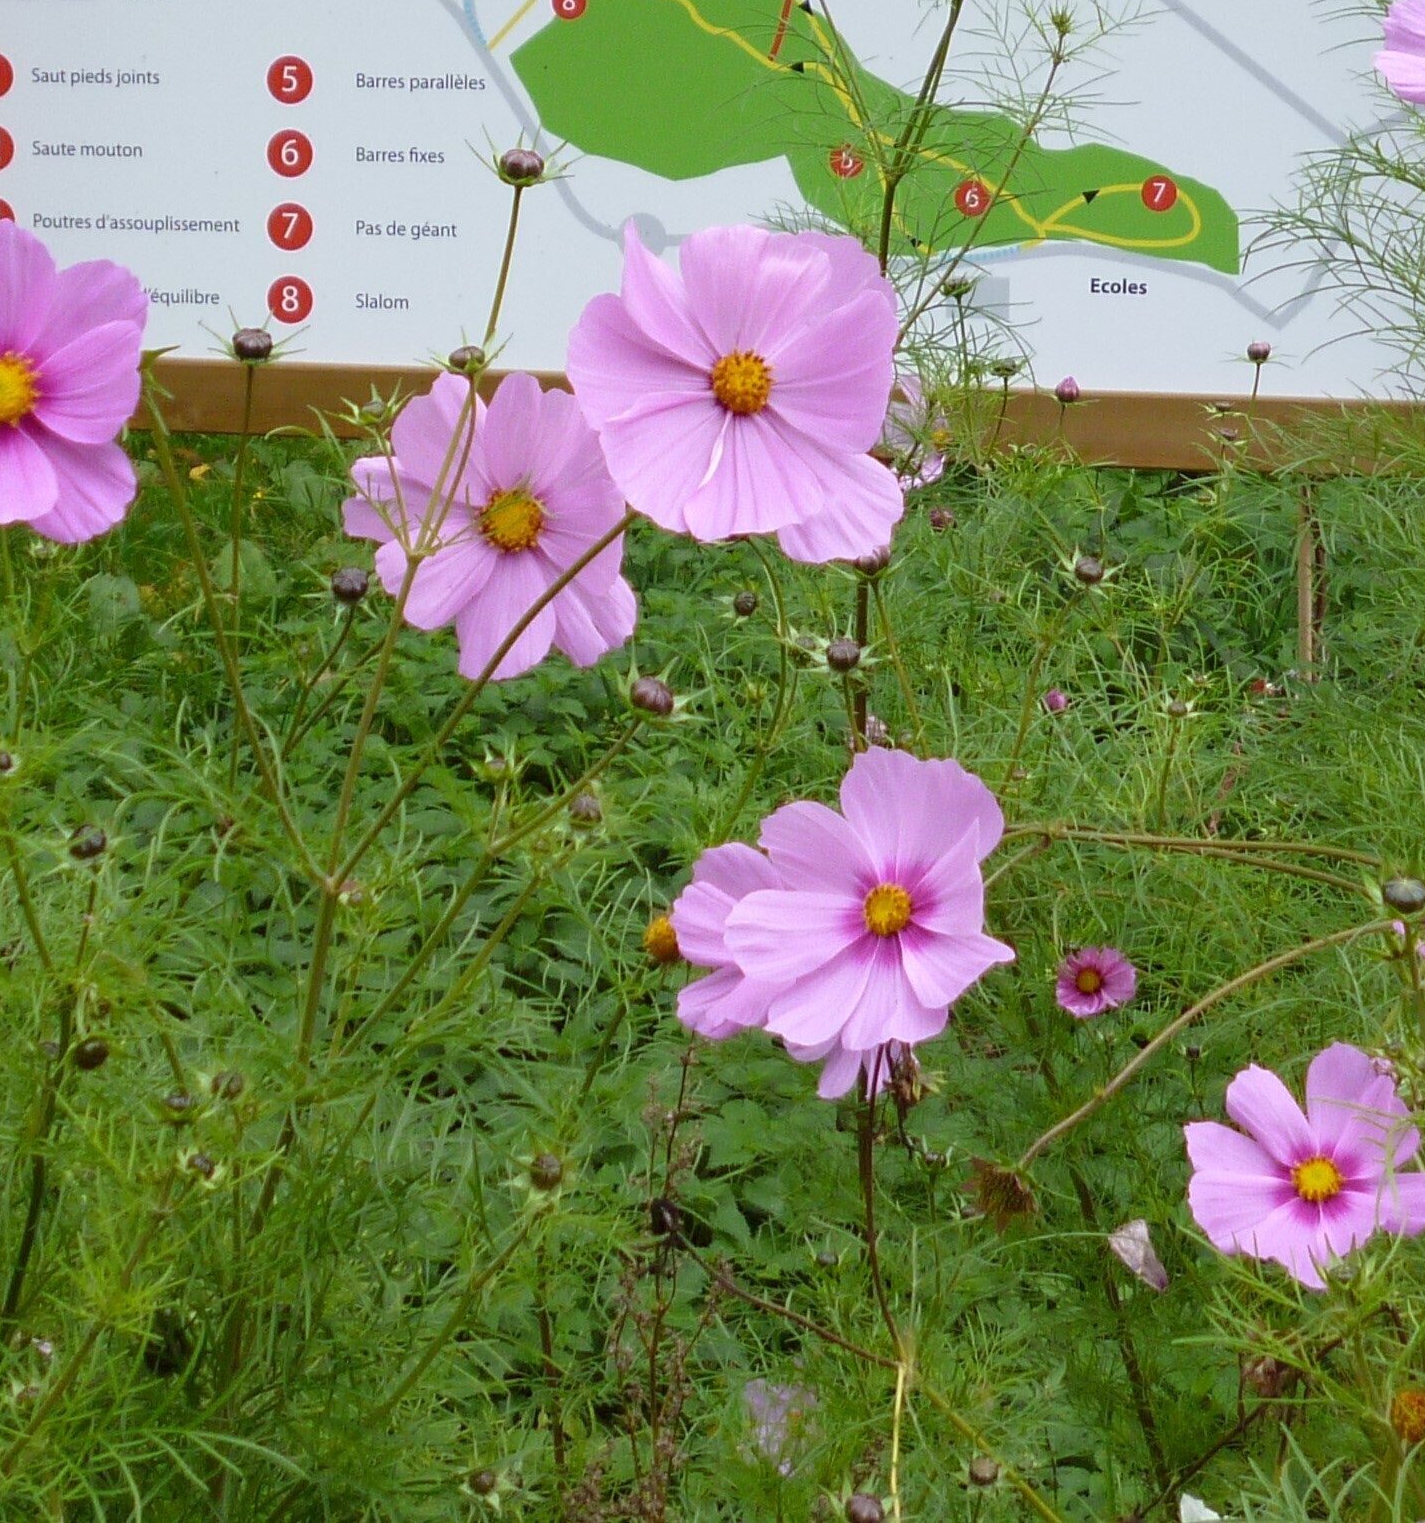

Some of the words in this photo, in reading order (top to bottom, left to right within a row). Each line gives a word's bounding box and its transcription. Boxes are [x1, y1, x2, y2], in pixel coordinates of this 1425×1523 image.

[31, 67, 67, 84] Saut
[70, 68, 113, 88] pieds
[115, 68, 160, 88] joints
[281, 65, 297, 92] 5
[356, 72, 405, 89] Barres
[409, 73, 486, 93] parallèles
[32, 140, 77, 158] Saute
[80, 142, 143, 159] mouton
[281, 139, 299, 166] 6
[356, 146, 405, 163] Barres
[409, 146, 445, 164] fixes
[965, 187, 980, 208] 6
[1153, 182, 1167, 203] 7
[32, 212, 92, 230] Poutres
[95, 213, 240, 235] d'assouplissement
[282, 212, 298, 239] 7
[356, 219, 382, 236] Pas
[386, 220, 407, 237] de
[410, 220, 457, 241] géant
[1090, 277, 1148, 295] Ecoles
[281, 285, 299, 312] 8
[355, 293, 410, 310] Slalom
